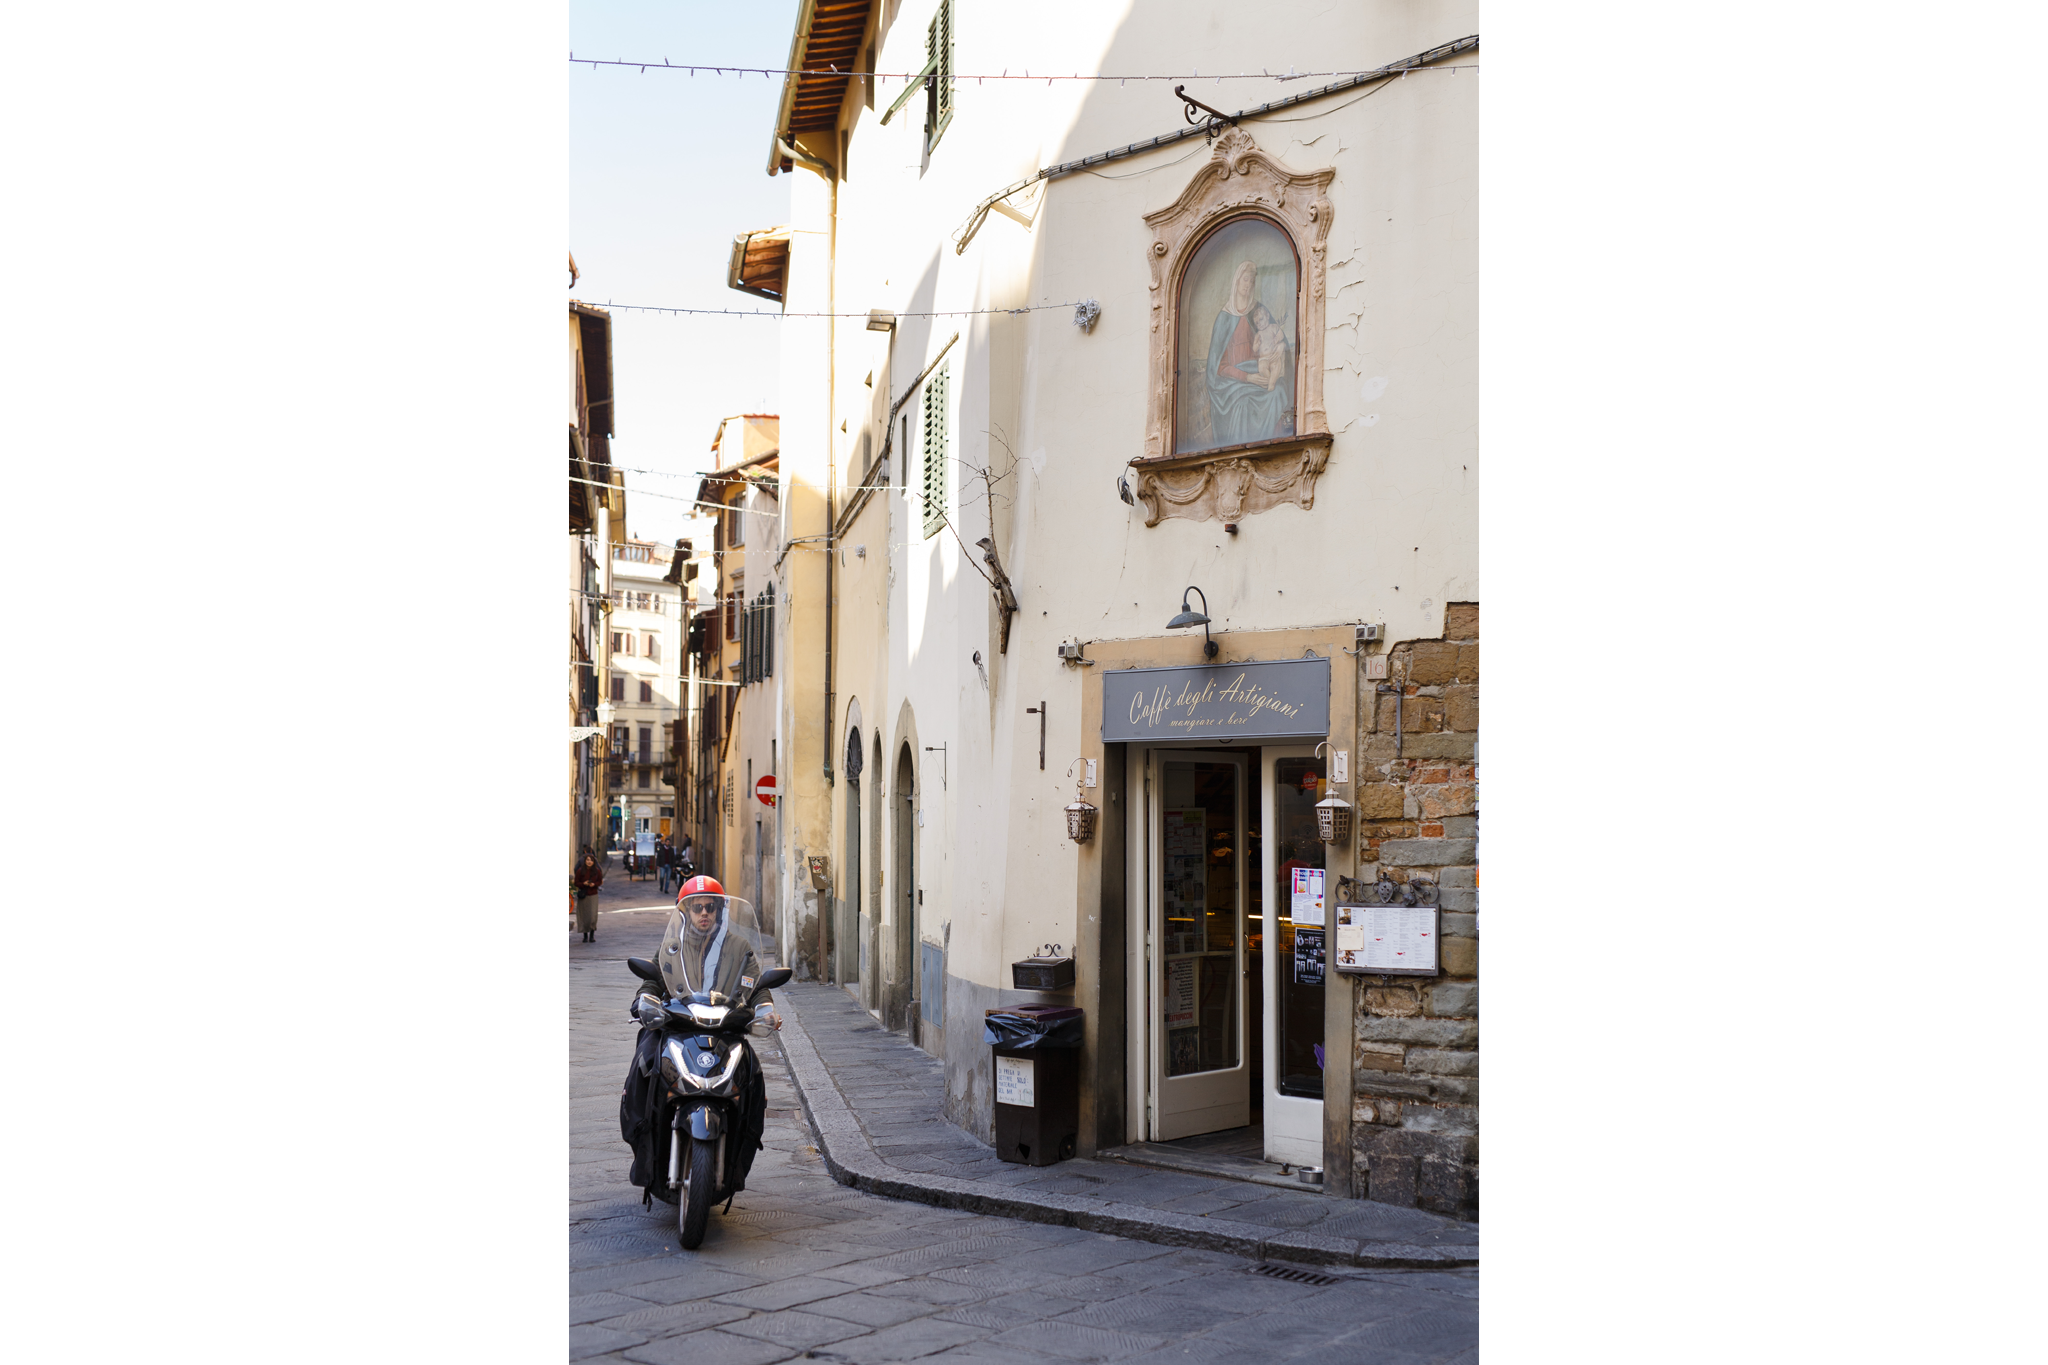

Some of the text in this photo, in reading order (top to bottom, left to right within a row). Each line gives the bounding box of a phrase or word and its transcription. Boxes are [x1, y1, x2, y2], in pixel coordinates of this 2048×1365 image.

[1369, 660, 1384, 675] 16
[1129, 672, 1305, 728] Caffè degli Artigiani
[1168, 711, 1248, 733] mangiare e bere
